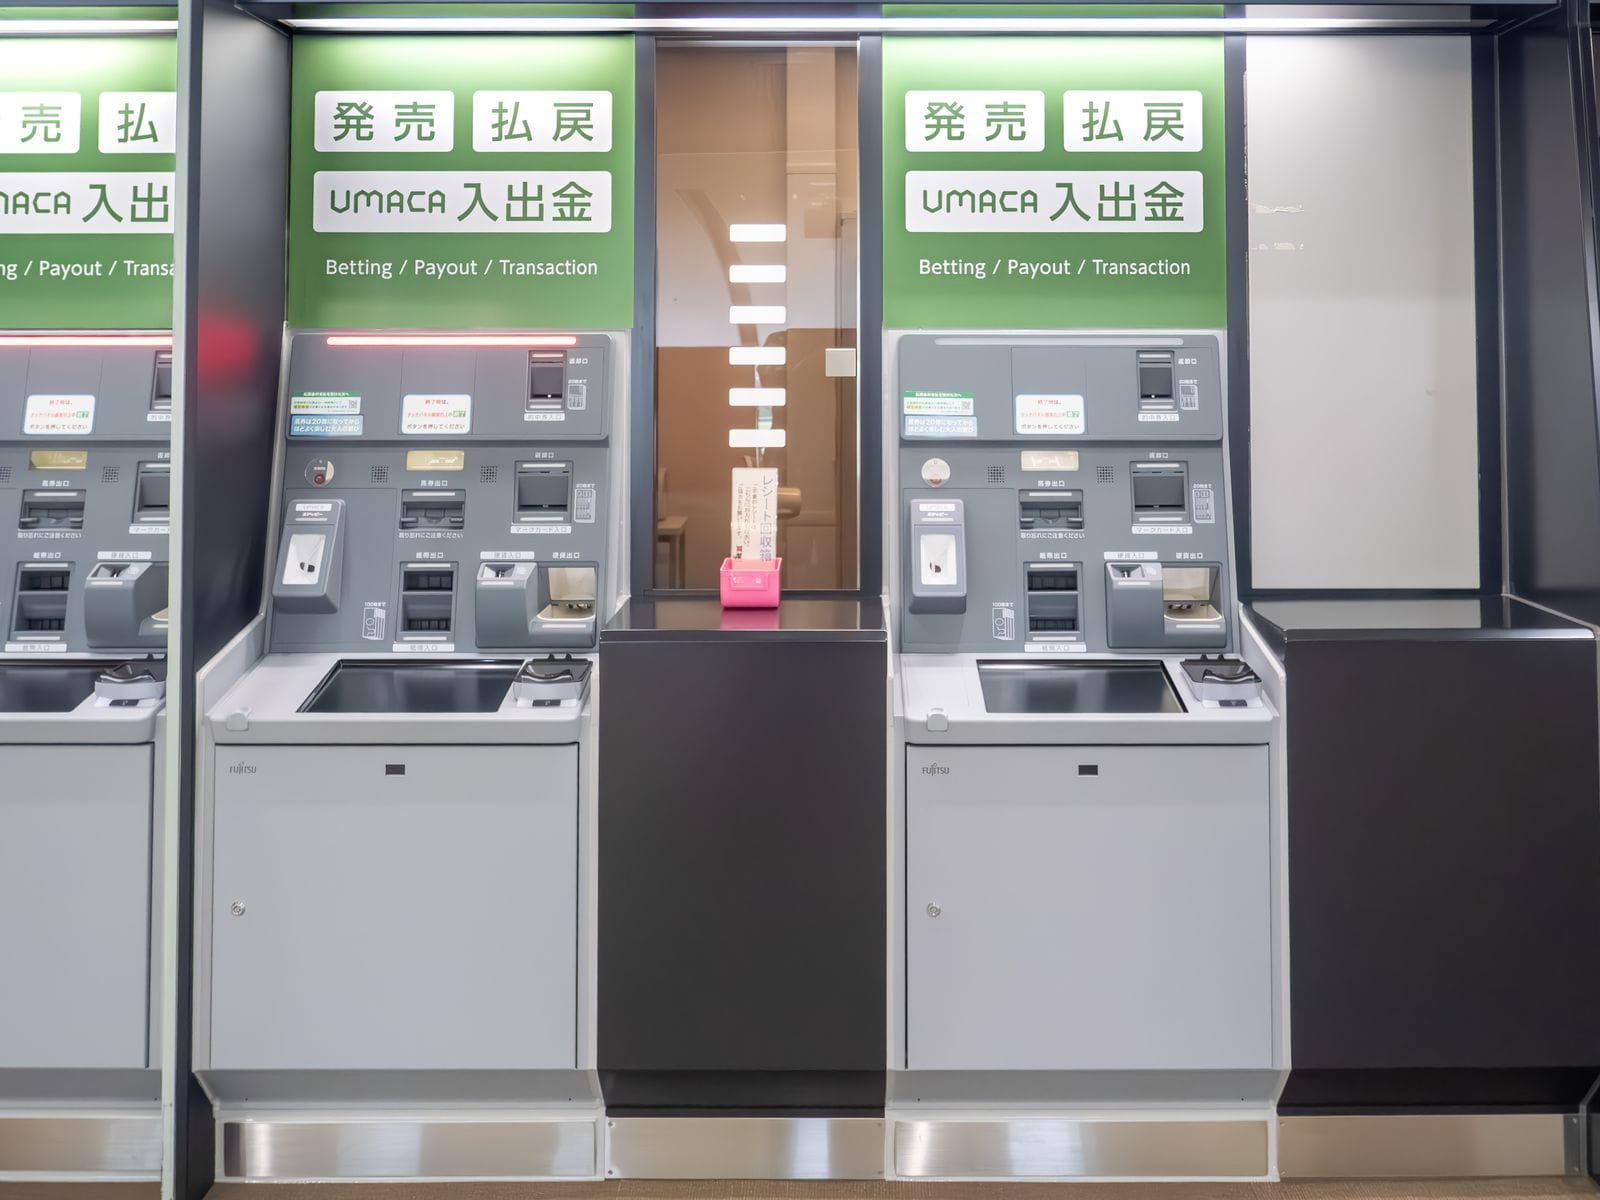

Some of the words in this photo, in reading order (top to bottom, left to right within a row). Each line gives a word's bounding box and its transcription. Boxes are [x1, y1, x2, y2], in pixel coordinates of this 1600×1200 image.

[116, 102, 159, 143] 払
[332, 101, 436, 142] 発売
[491, 101, 594, 142] 払戻
[924, 101, 1027, 142] 発売
[1082, 101, 1185, 142] 払戻
[81, 182, 169, 222] 入出
[329, 189, 446, 214] UMACA
[456, 181, 593, 222] 入出金
[922, 189, 1038, 214] UMACA
[1049, 180, 1185, 222] 入出金
[39, 260, 103, 281] Payout
[326, 259, 393, 280] Betting
[414, 259, 478, 280] Payout
[498, 259, 598, 276] Transaction
[919, 258, 987, 280] Betting
[1007, 259, 1071, 280] Payout
[1091, 258, 1191, 275] Transaction
[922, 762, 950, 777] FUJITSU
